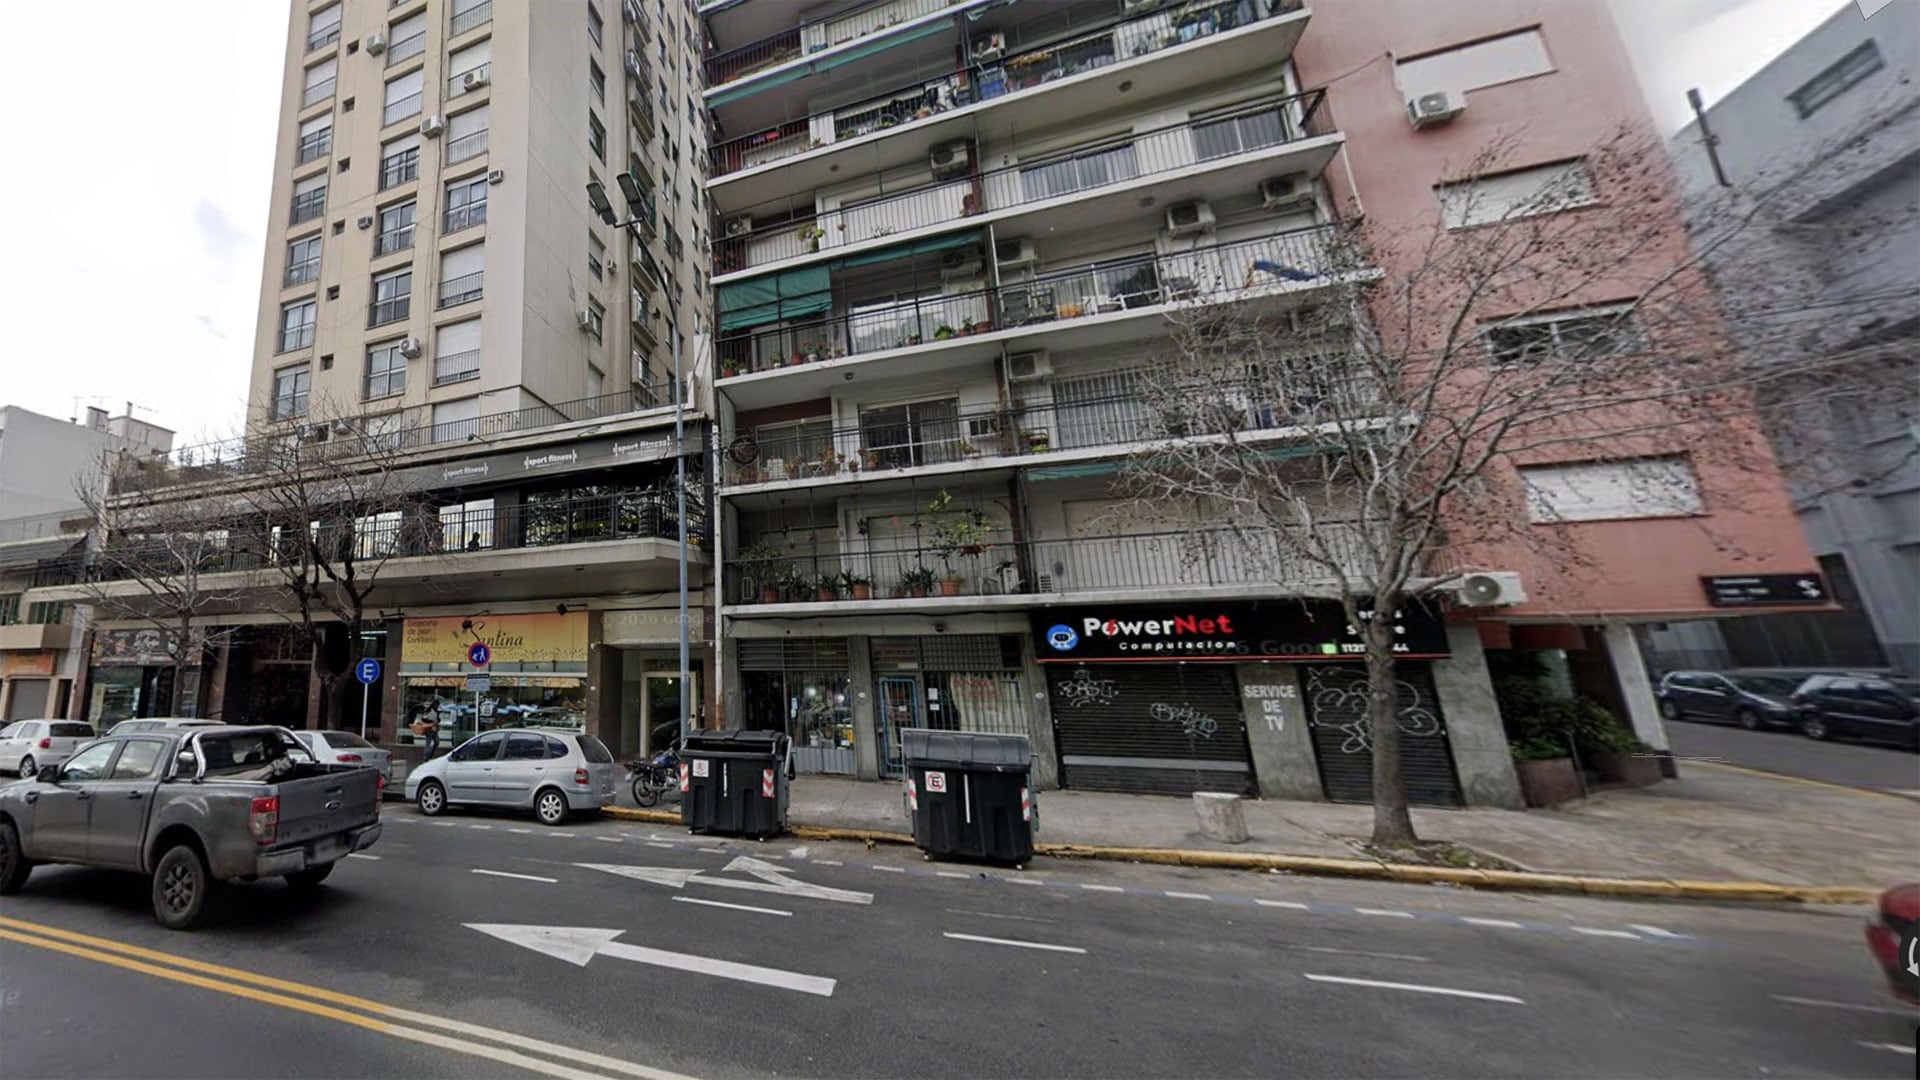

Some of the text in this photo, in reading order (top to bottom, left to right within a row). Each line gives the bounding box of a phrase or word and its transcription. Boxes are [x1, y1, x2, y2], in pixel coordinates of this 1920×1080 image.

[1083, 614, 1235, 638] PowerNet
[1119, 641, 1237, 651] Computacion
[1244, 684, 1297, 698] SERVICE
[1263, 700, 1282, 713] DE
[1264, 715, 1284, 731] TV
